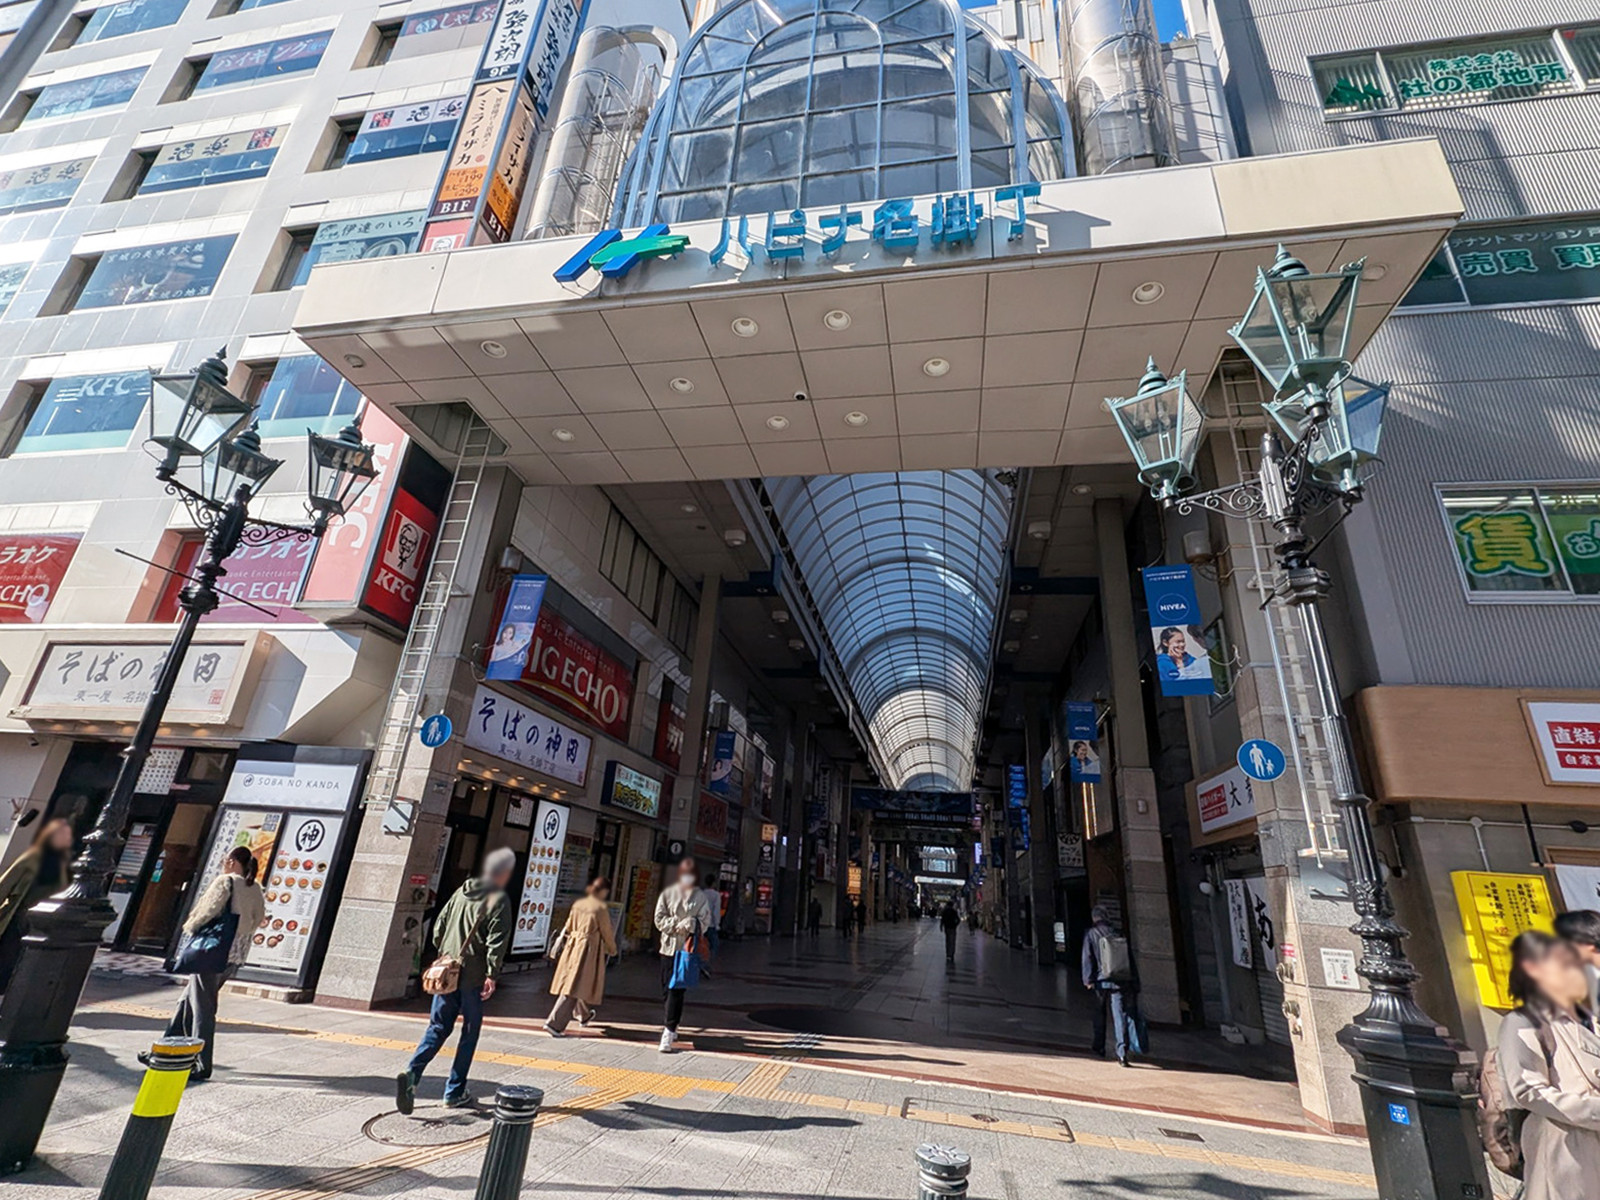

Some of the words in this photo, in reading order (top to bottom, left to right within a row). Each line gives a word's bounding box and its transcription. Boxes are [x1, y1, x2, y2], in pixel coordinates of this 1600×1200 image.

[213, 38, 313, 70] バイキング
[1429, 50, 1519, 72] 株式会社
[489, 65, 511, 77] 9F
[455, 99, 487, 166] ミライザカ
[440, 200, 471, 214] B1F
[708, 182, 1042, 266] ハピナ名掛丁
[1452, 235, 1506, 248] テナント
[1510, 229, 1582, 242] マンション
[1458, 248, 1538, 277] 売買
[76, 373, 138, 397] KFC
[251, 570, 301, 579] Entertainm
[374, 567, 415, 602] KFC
[0, 583, 50, 607] CHO
[248, 581, 298, 601] ECH
[1160, 603, 1187, 612] NIVEA
[524, 637, 560, 680] IG
[560, 657, 620, 724] ECHO
[478, 696, 579, 764] そばの神田
[1553, 726, 1600, 745] 直結
[258, 778, 284, 787] SOBA
[287, 779, 302, 788] NO
[306, 780, 340, 790] KANDA
[301, 824, 321, 848] 神
